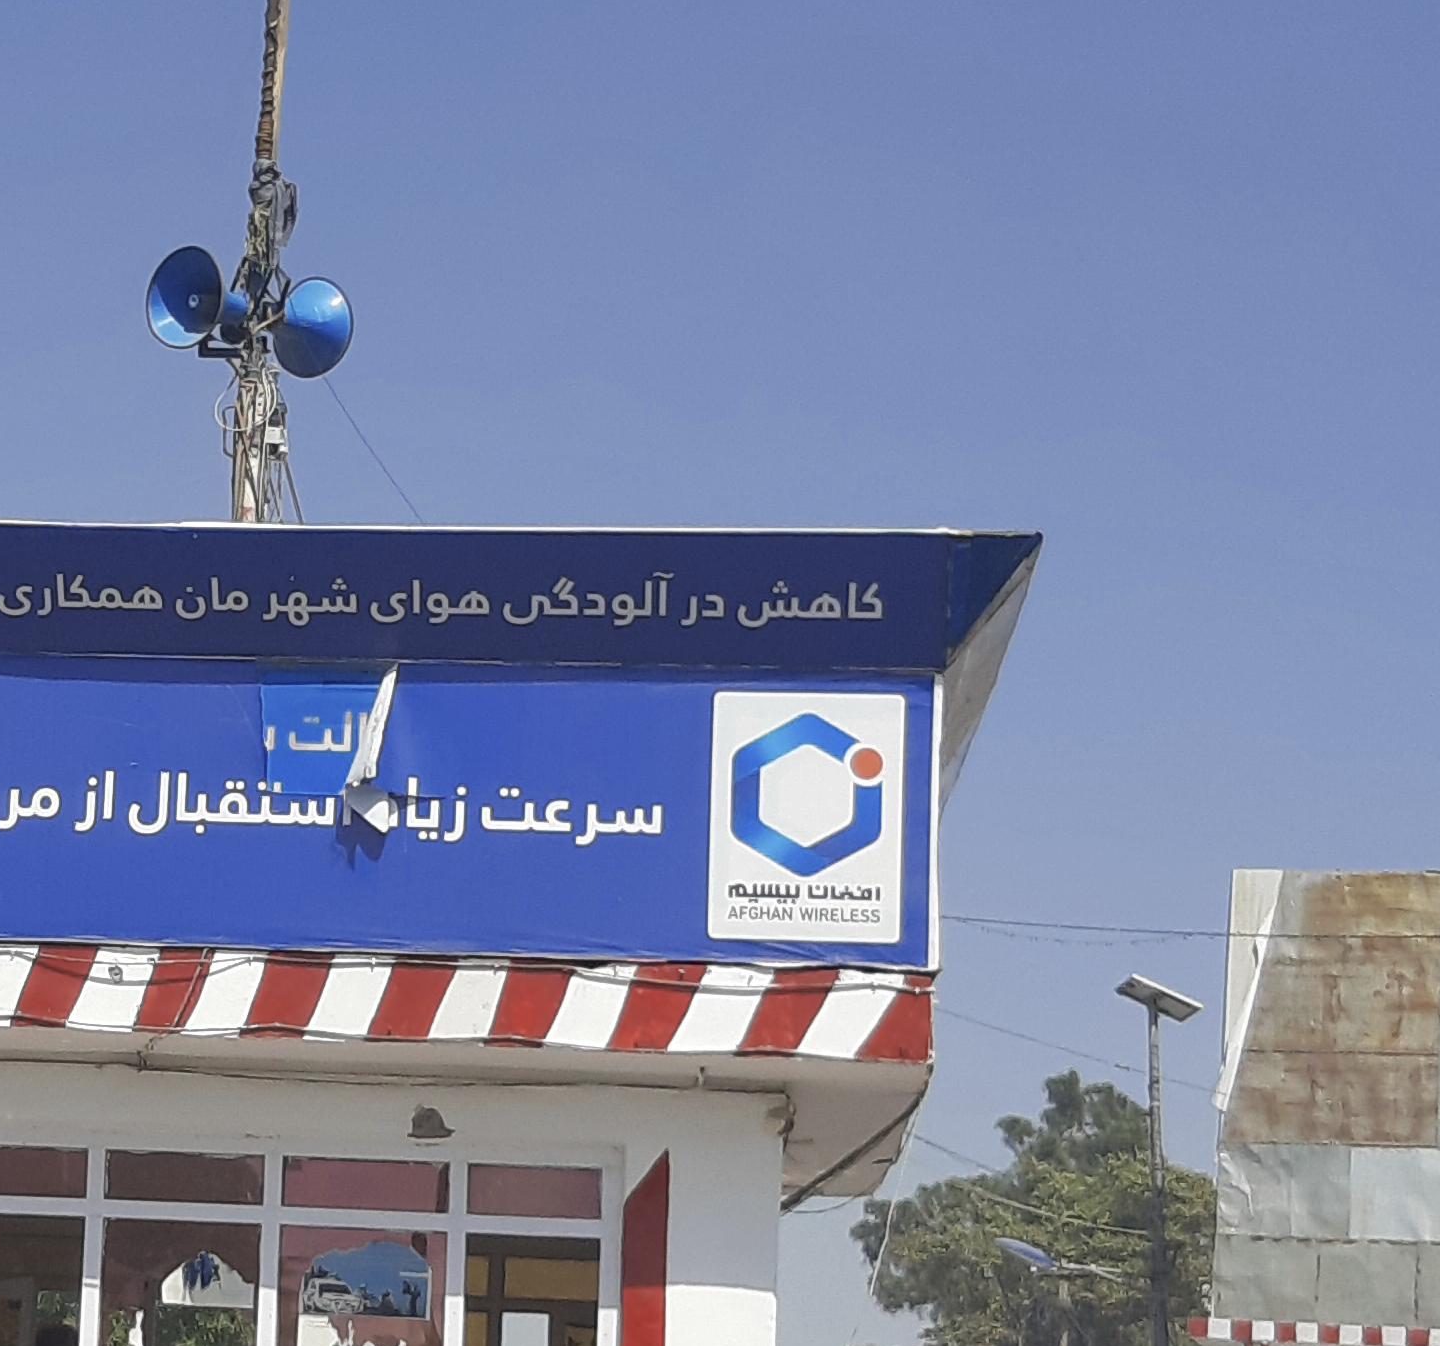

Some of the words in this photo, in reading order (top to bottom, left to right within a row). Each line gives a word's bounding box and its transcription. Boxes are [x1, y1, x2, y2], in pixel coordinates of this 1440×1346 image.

[174, 577, 249, 621] مان
[261, 576, 359, 623] شهر
[368, 578, 491, 625] هوای
[501, 571, 675, 628] آلودگی
[678, 590, 725, 629] در
[735, 579, 886, 628] کاهش
[73, 769, 117, 833] از
[387, 776, 469, 842] زیا
[479, 784, 665, 846] سرعت
[727, 905, 794, 922] AFGHAN
[798, 907, 881, 924] WIRELESS
